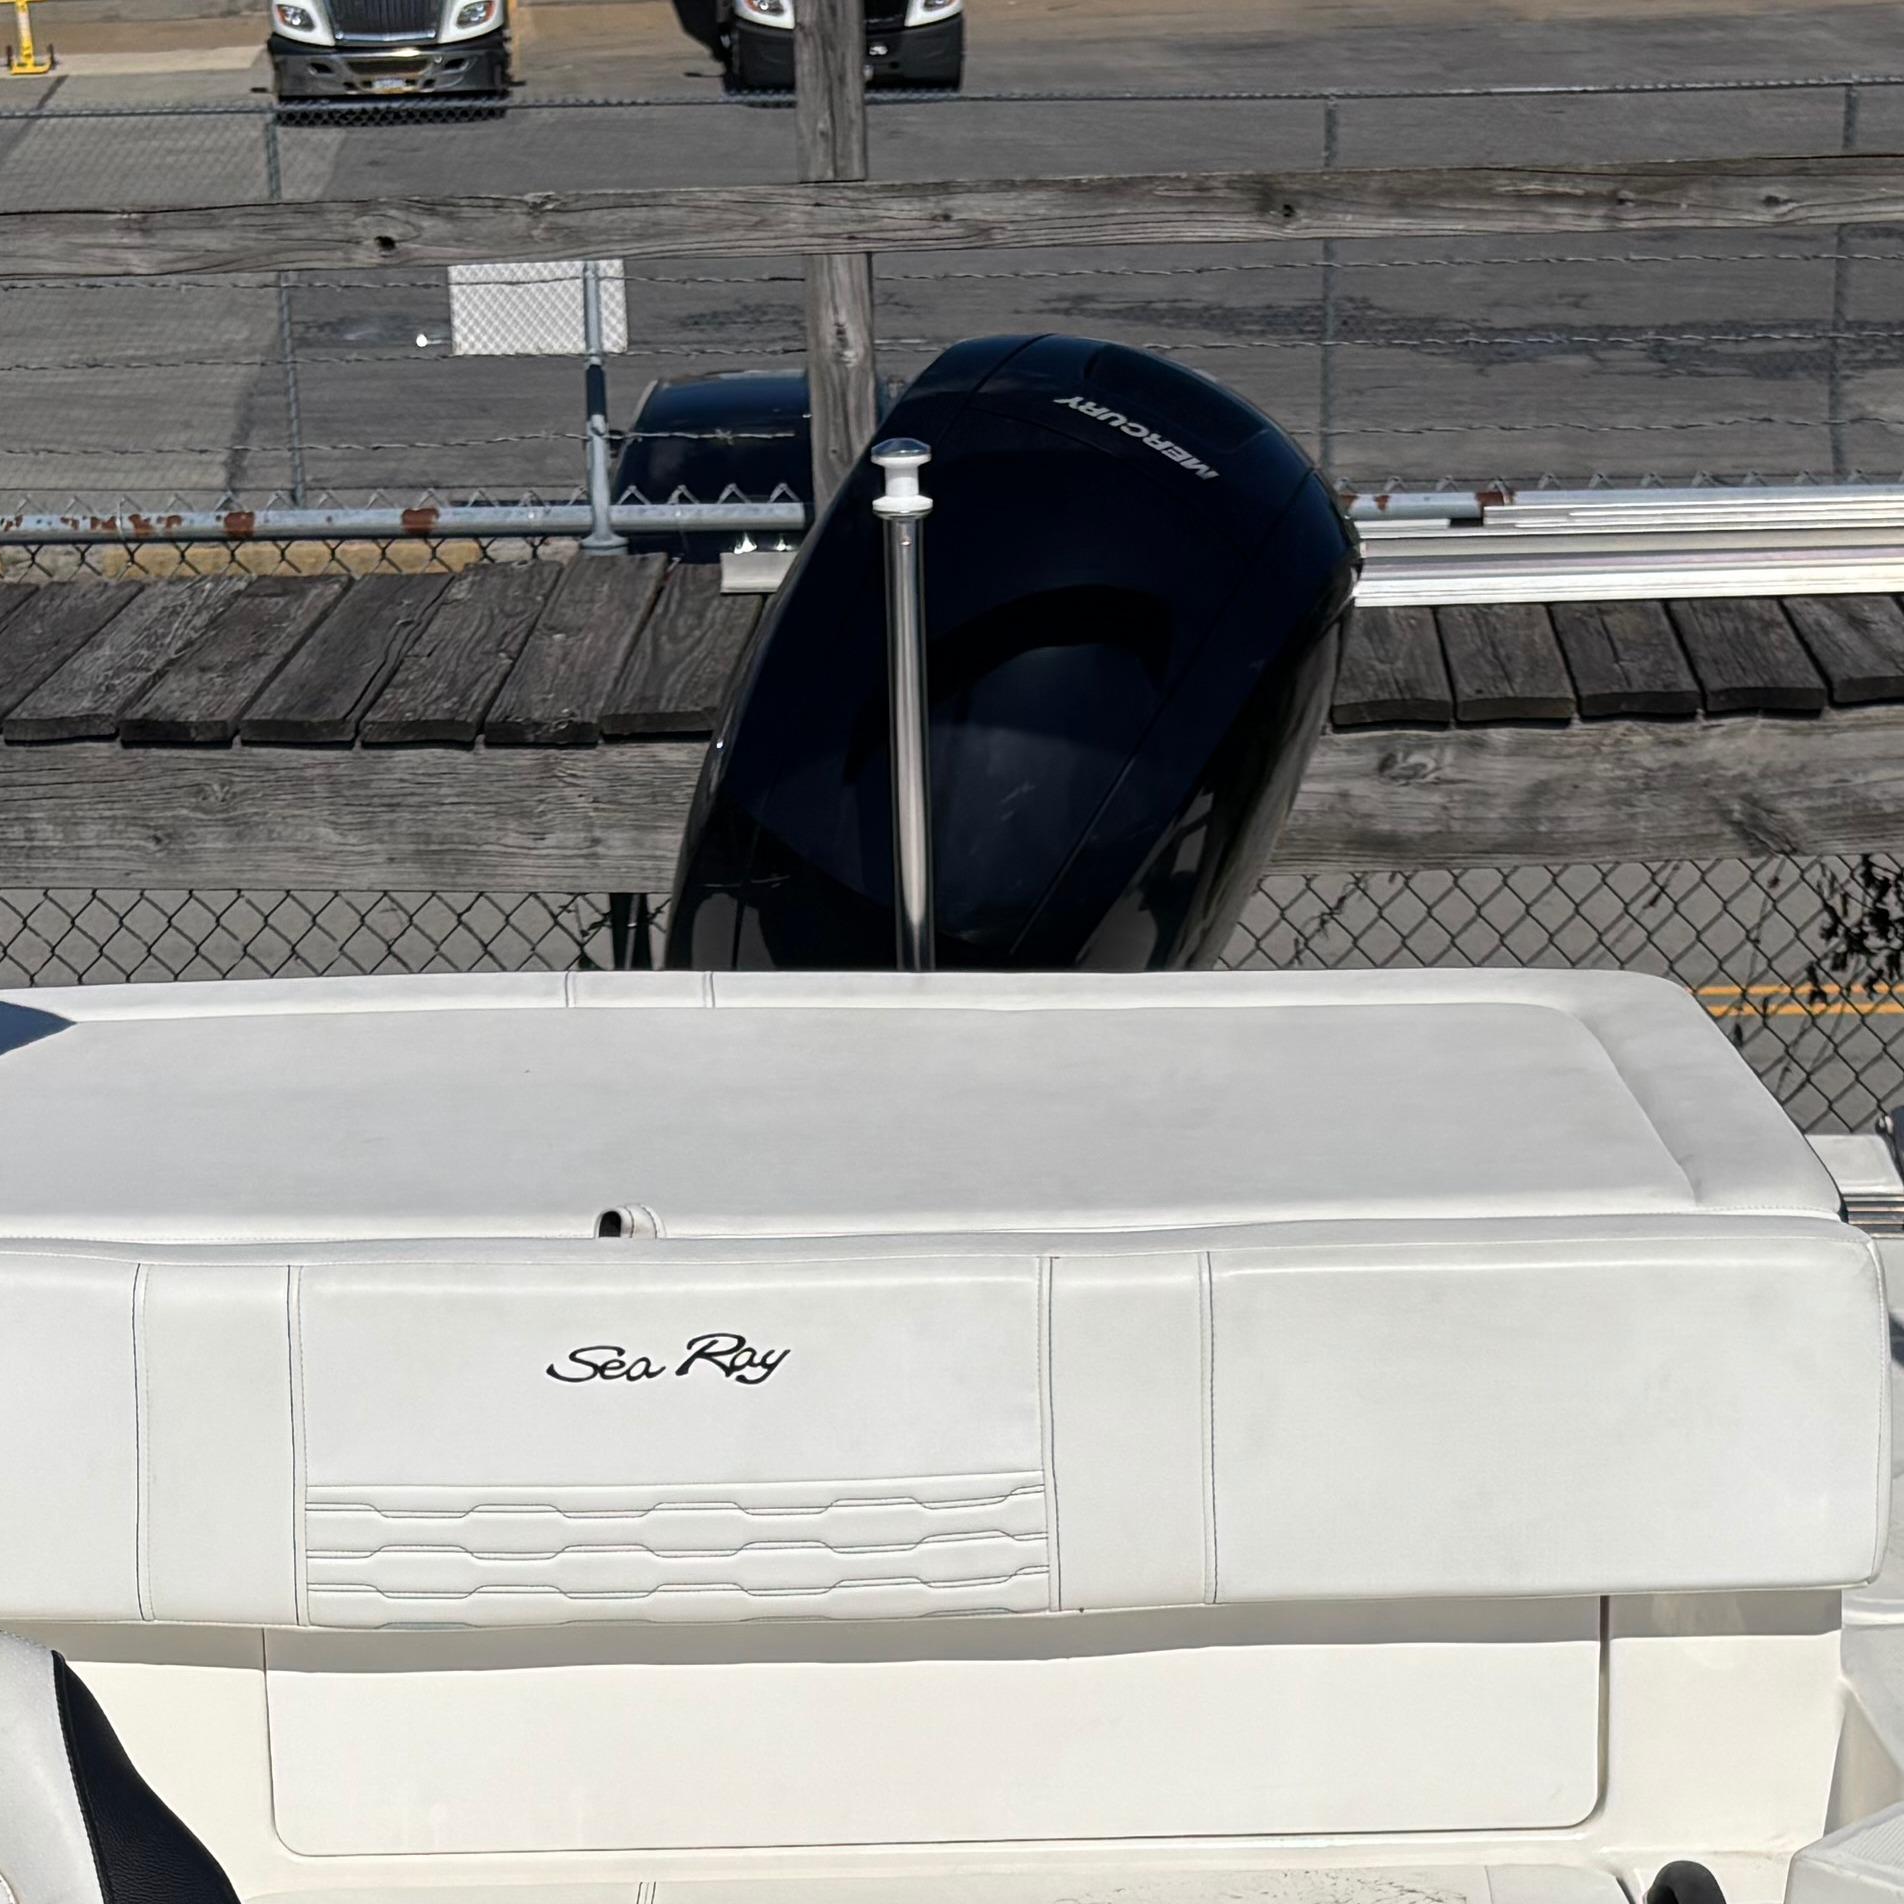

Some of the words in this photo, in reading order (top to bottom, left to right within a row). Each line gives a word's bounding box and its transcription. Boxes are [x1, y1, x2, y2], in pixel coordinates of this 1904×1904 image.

[1053, 396, 1220, 480] MERCURY
[546, 1345, 666, 1383] Sea
[675, 1333, 791, 1385] Ray
